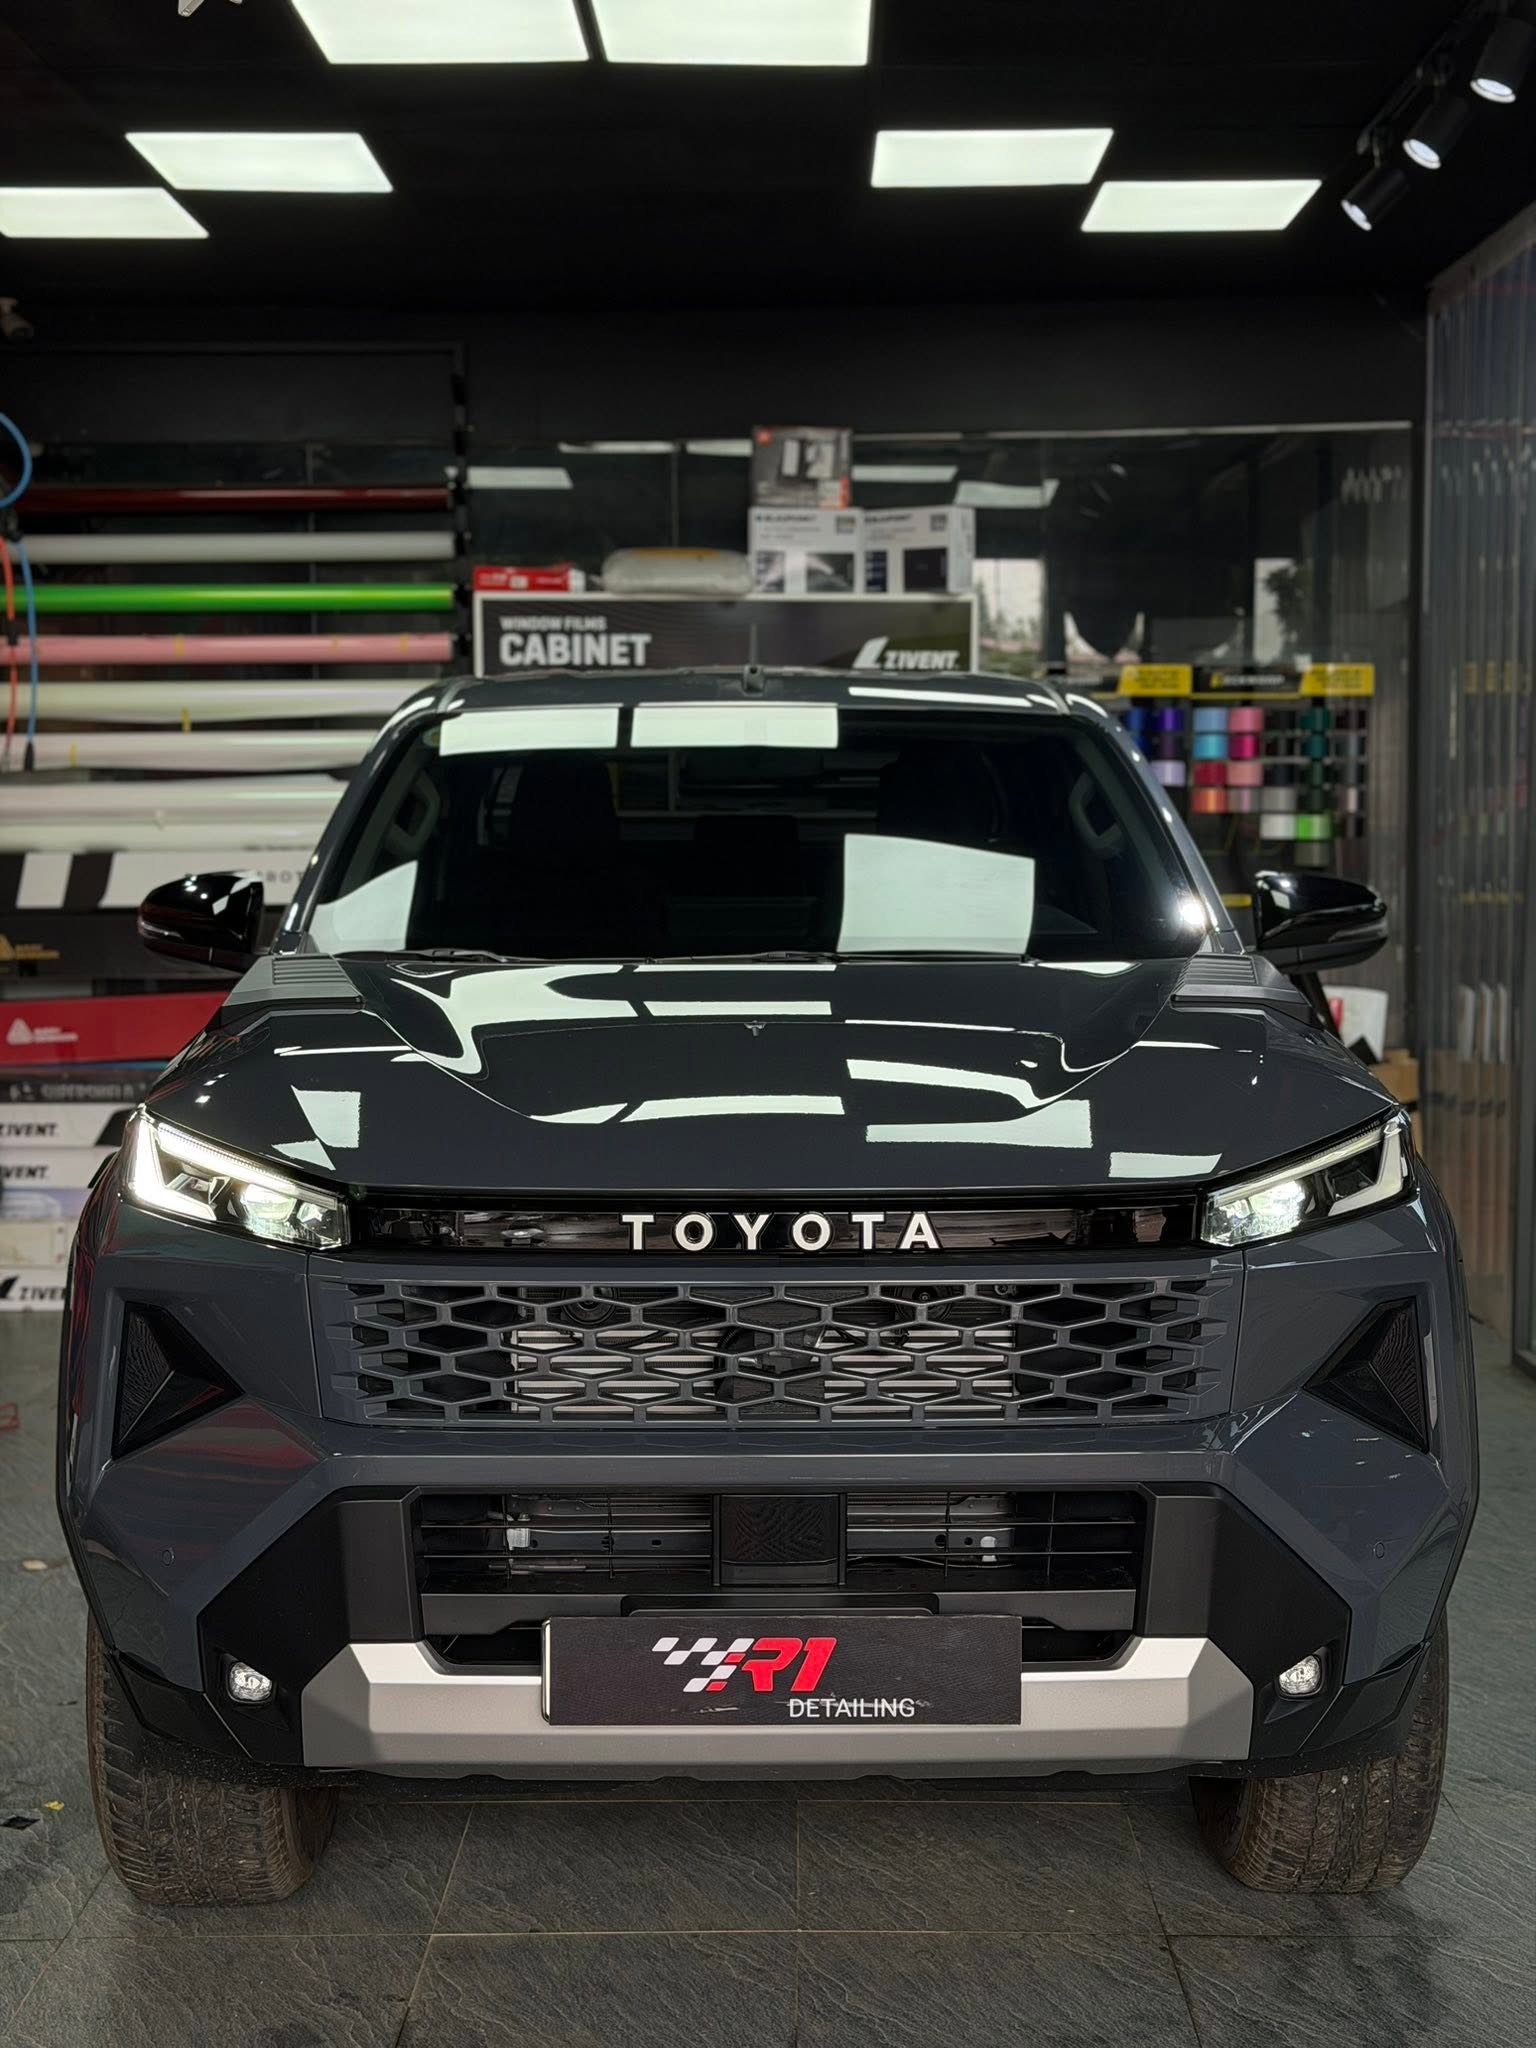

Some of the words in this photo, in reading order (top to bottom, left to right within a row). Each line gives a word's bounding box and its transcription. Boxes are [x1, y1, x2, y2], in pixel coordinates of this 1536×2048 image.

[499, 615, 563, 632] WINDOW
[564, 615, 608, 632] FILMS
[499, 633, 652, 666] CABINET
[884, 649, 960, 670] ZIVENT
[622, 1213, 941, 1251] TOYOTA
[742, 1637, 838, 1692] R1
[788, 1698, 916, 1718] DETAILING
